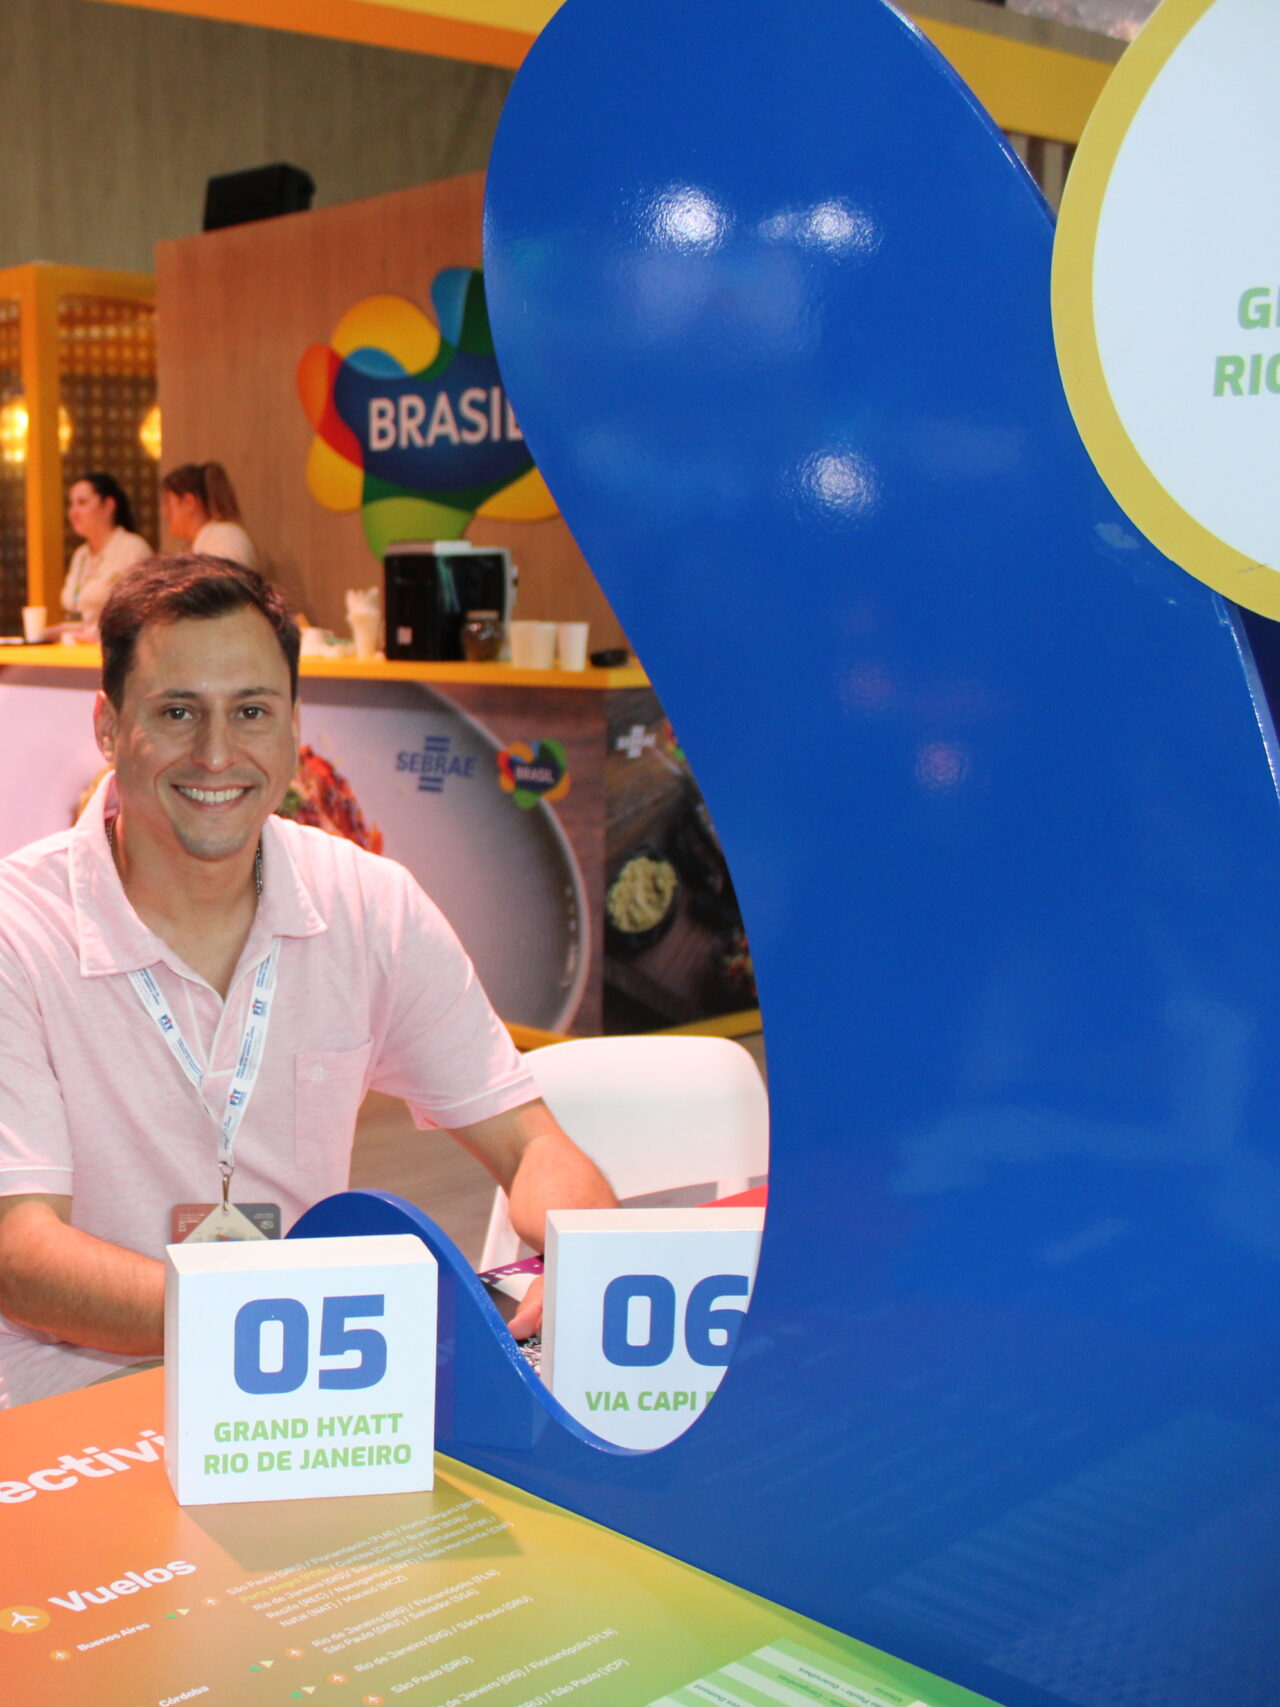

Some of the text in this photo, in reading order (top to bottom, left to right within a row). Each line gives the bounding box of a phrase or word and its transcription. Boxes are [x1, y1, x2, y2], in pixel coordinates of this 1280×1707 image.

[1237, 286, 1280, 330] G
[395, 750, 477, 779] SEBRAE
[516, 764, 554, 784] BRASIL
[602, 1274, 749, 1368] 06
[233, 1293, 388, 1396] 05
[585, 1391, 629, 1411] VIA
[637, 1391, 697, 1411] CAPI
[214, 1412, 405, 1444] GRAND HYATT
[203, 1443, 413, 1476] RIO DE JANEIRO
[47, 1560, 197, 1612] Vuelos
[246, 1575, 277, 1586] Paulo
[252, 1602, 272, 1610] Rio
[272, 1596, 286, 1604] de
[284, 1581, 324, 1599] Janeiro
[350, 1556, 393, 1574] Salvador
[265, 1604, 300, 1618] Recife
[298, 1592, 330, 1607] (REC)
[334, 1570, 391, 1592] Navegantes
[422, 1548, 447, 1559] Belo
[445, 1532, 489, 1550] Horizonte
[279, 1614, 309, 1627] Natal
[307, 1602, 338, 1617] (NAT)
[376, 1575, 409, 1589] (MCZ)
[311, 1636, 331, 1647] Rio
[331, 1632, 345, 1641] de
[344, 1615, 384, 1635] Janeiro
[413, 1579, 474, 1606] Florianópolis
[76, 1623, 151, 1651] Buenos Aires
[322, 1641, 346, 1654] São
[344, 1630, 375, 1646] Paulo
[408, 1600, 452, 1619] Salvador
[353, 1660, 374, 1673] Rio
[374, 1654, 389, 1665] de
[386, 1639, 428, 1659] Janeiro
[424, 1628, 454, 1644] (GIG)
[456, 1617, 478, 1630] São
[475, 1605, 505, 1621] Paulo
[501, 1594, 534, 1611] (GRU)
[390, 1655, 475, 1694] São Paulo (GRU)
[446, 1698, 461, 1707] de
[458, 1681, 500, 1702] Janeiro
[496, 1668, 526, 1685] (GIG)
[529, 1638, 592, 1670] Florianópolis
[587, 1627, 619, 1644] (FLN)
[551, 1685, 573, 1697] São
[570, 1671, 601, 1688] Paulo
[159, 1686, 210, 1707] Córdoba
